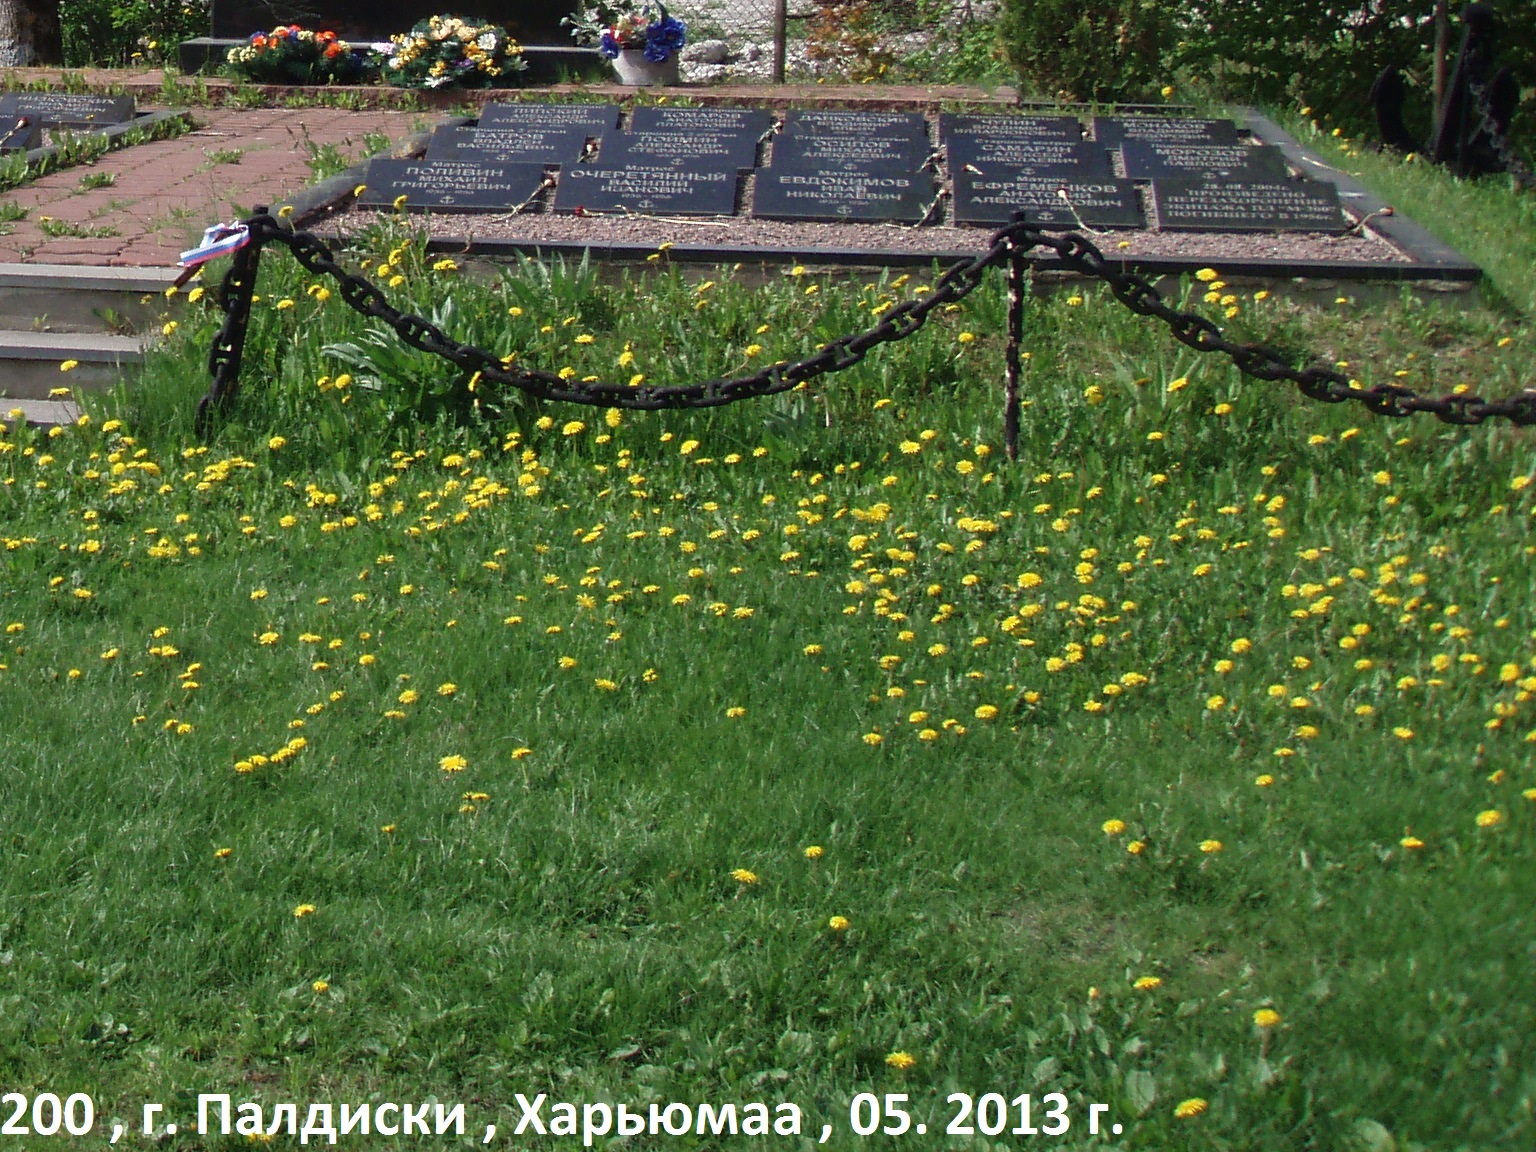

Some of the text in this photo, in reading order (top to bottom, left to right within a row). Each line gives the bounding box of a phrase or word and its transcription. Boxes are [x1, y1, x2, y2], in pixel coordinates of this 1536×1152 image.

[813, 140, 892, 149] ОСИПОВ
[982, 144, 1072, 154] САМАРИН
[1155, 147, 1249, 157] МОРОЗОВ
[431, 161, 481, 169] Матрос
[625, 164, 676, 172] Матрос
[405, 166, 504, 177] ПОЛИВИН
[569, 169, 727, 182] ОЧЕРЕТЯННЫЙ
[817, 169, 870, 177] Матрос
[418, 175, 488, 183] МИХАИЛ
[778, 175, 911, 188] ЕВДОКИМОВ
[1015, 175, 1068, 184] Матрос
[391, 181, 512, 191] ГРИГОРЬЕВИЧ
[971, 181, 1118, 194] ЕФРЕМЕНКОВ
[785, 190, 902, 201] НИКОЛАЕВИЧ
[999, 190, 1093, 199] АНАТОИЙ
[1188, 189, 1307, 199] ПРОИЗВЕДЕНО
[1167, 195, 1329, 206] ПЕРЕЗАХОРОНЕНИЕ
[1163, 202, 1247, 212] ЭКИПАЖА
[1167, 210, 1275, 220] ПОГИБШЕГО
